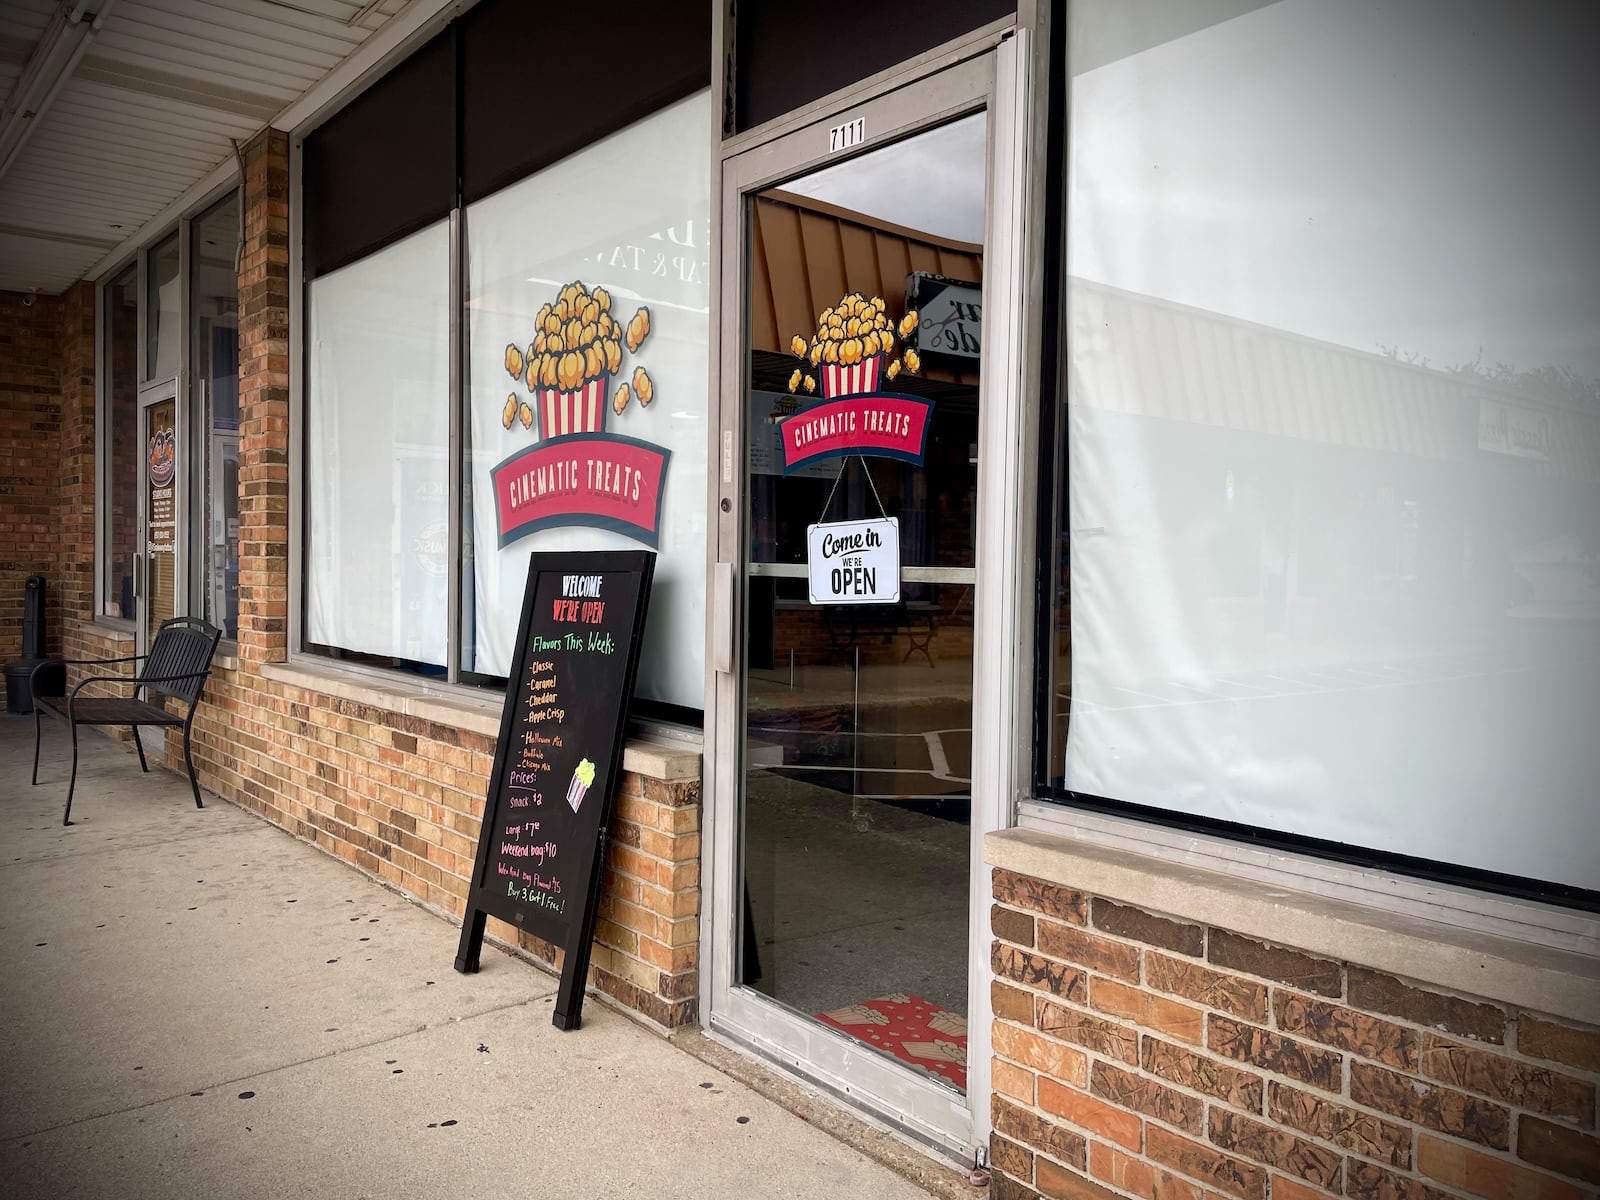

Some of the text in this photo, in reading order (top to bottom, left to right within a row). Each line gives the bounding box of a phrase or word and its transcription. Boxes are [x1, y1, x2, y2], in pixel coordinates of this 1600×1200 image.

[831, 119, 863, 151] 7111
[794, 409, 911, 448] CINEMATIC TREATS
[509, 459, 643, 509] CINEMATIC TREATS
[822, 527, 883, 559] Come in
[842, 557, 862, 567] WE'RE
[562, 575, 603, 598] WELCOME
[831, 567, 876, 596] OPEN
[552, 599, 605, 624] WE'RE OPEN
[532, 631, 616, 655] Flavors This Week:
[507, 881, 521, 901] Buy
